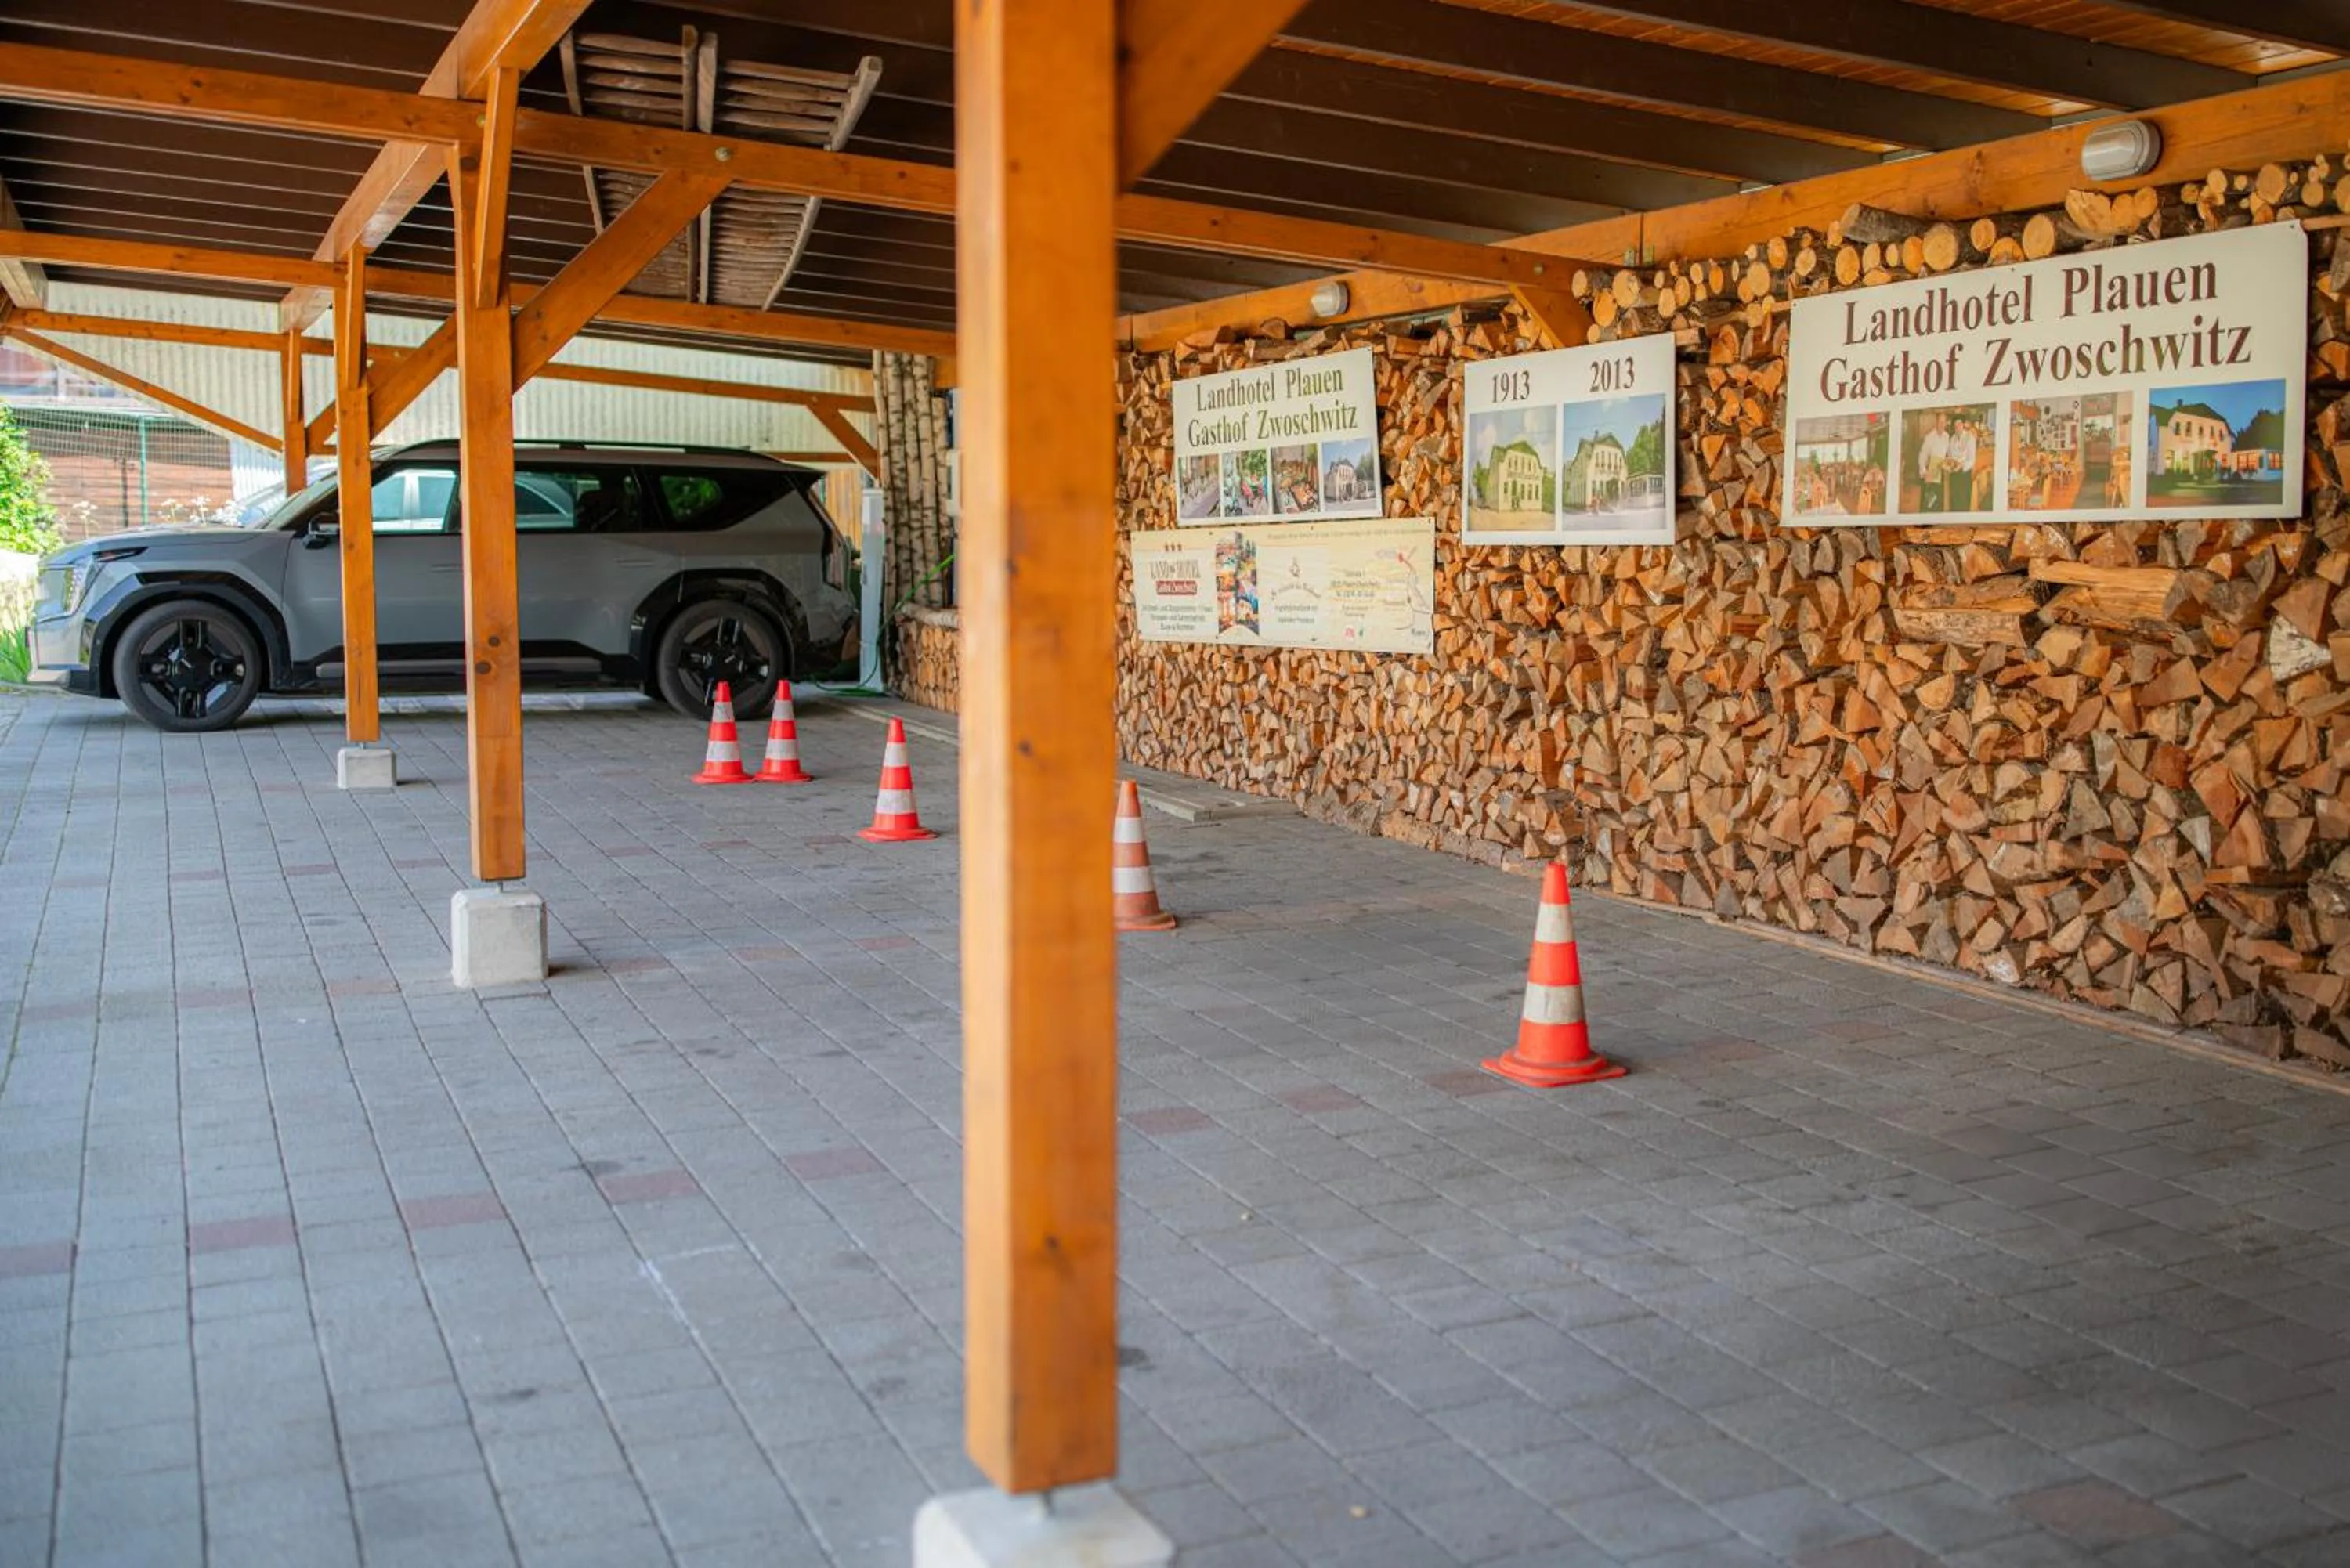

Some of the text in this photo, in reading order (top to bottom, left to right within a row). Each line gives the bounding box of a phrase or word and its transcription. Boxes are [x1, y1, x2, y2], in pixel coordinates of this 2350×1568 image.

[1844, 262, 2218, 345] Landhotel Plauen
[1491, 356, 1636, 403] 1913 2013
[1820, 315, 2253, 403] Gasthof Zwoschwitz
[1197, 367, 1343, 412] Landhotel Plauen
[1188, 399, 1358, 447] Gasthof Zwoschwitz
